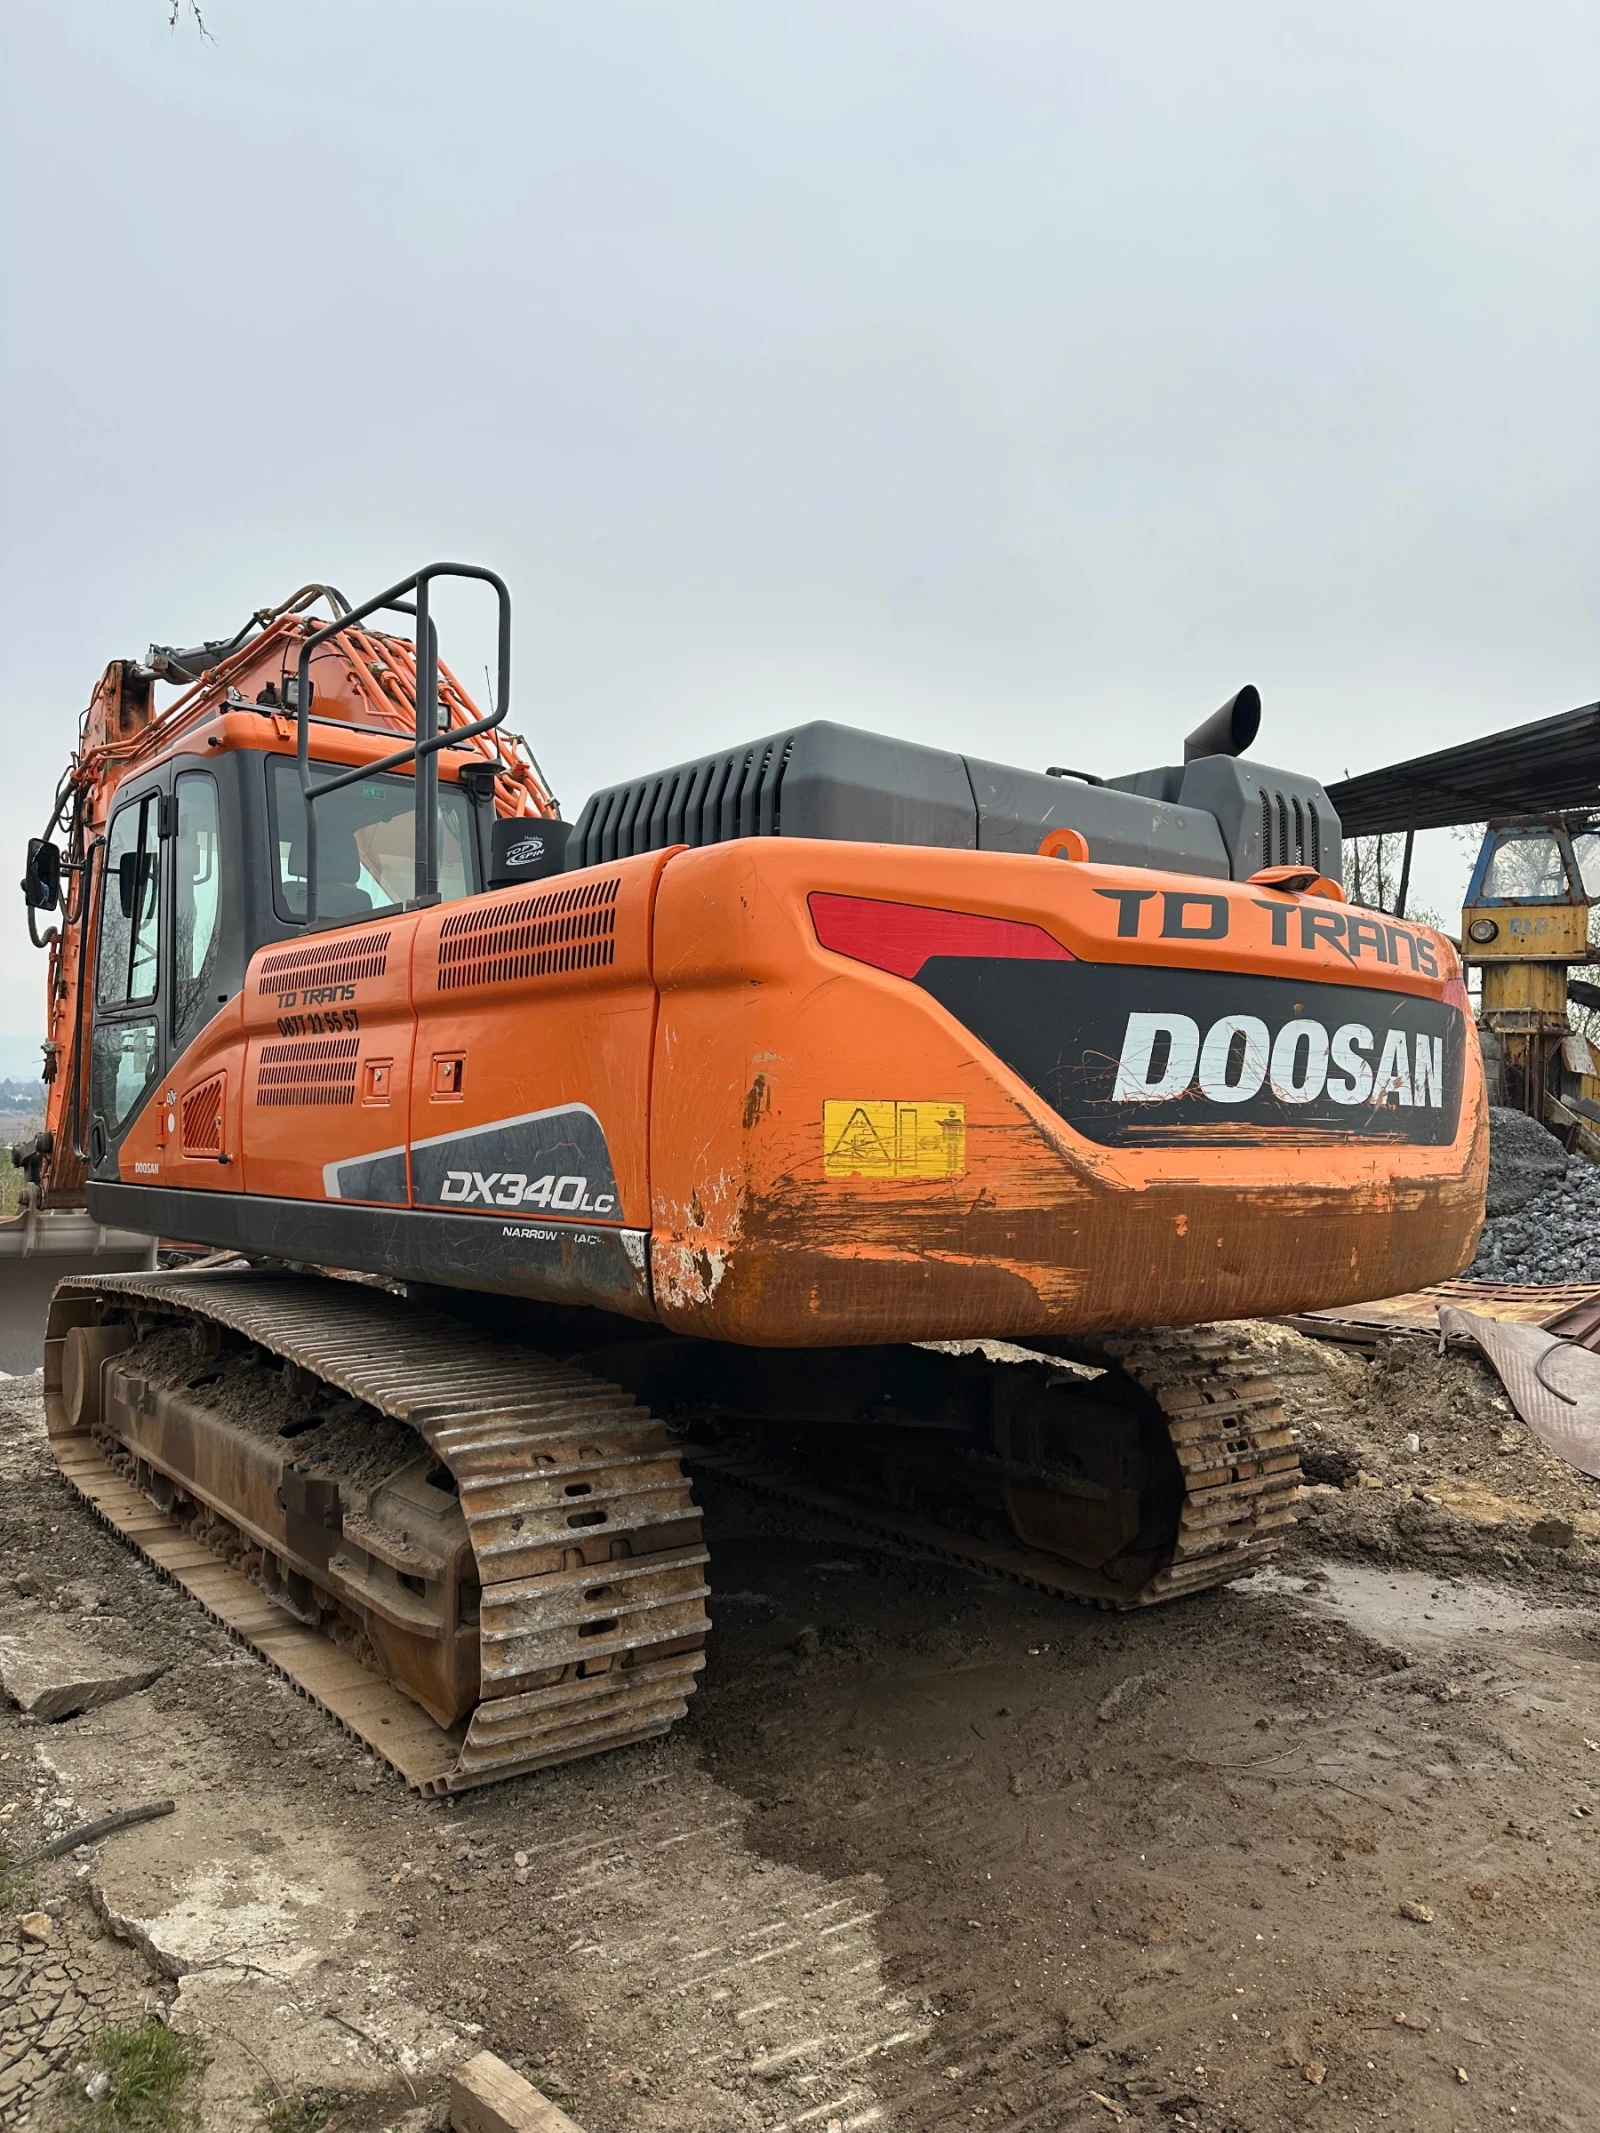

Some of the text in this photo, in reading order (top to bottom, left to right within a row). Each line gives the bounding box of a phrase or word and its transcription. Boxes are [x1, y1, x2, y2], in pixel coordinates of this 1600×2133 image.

[506, 845, 530, 857] TOP
[519, 849, 545, 861] SPIN
[1092, 888, 1439, 978] TD TRANS
[277, 983, 357, 1009] TD TRANS
[276, 1009, 359, 1038] 0877 22 55 57
[1112, 1012, 1443, 1108] DOOSAN
[135, 1162, 159, 1174] DOOSAN
[502, 1226, 558, 1241] NARROW
